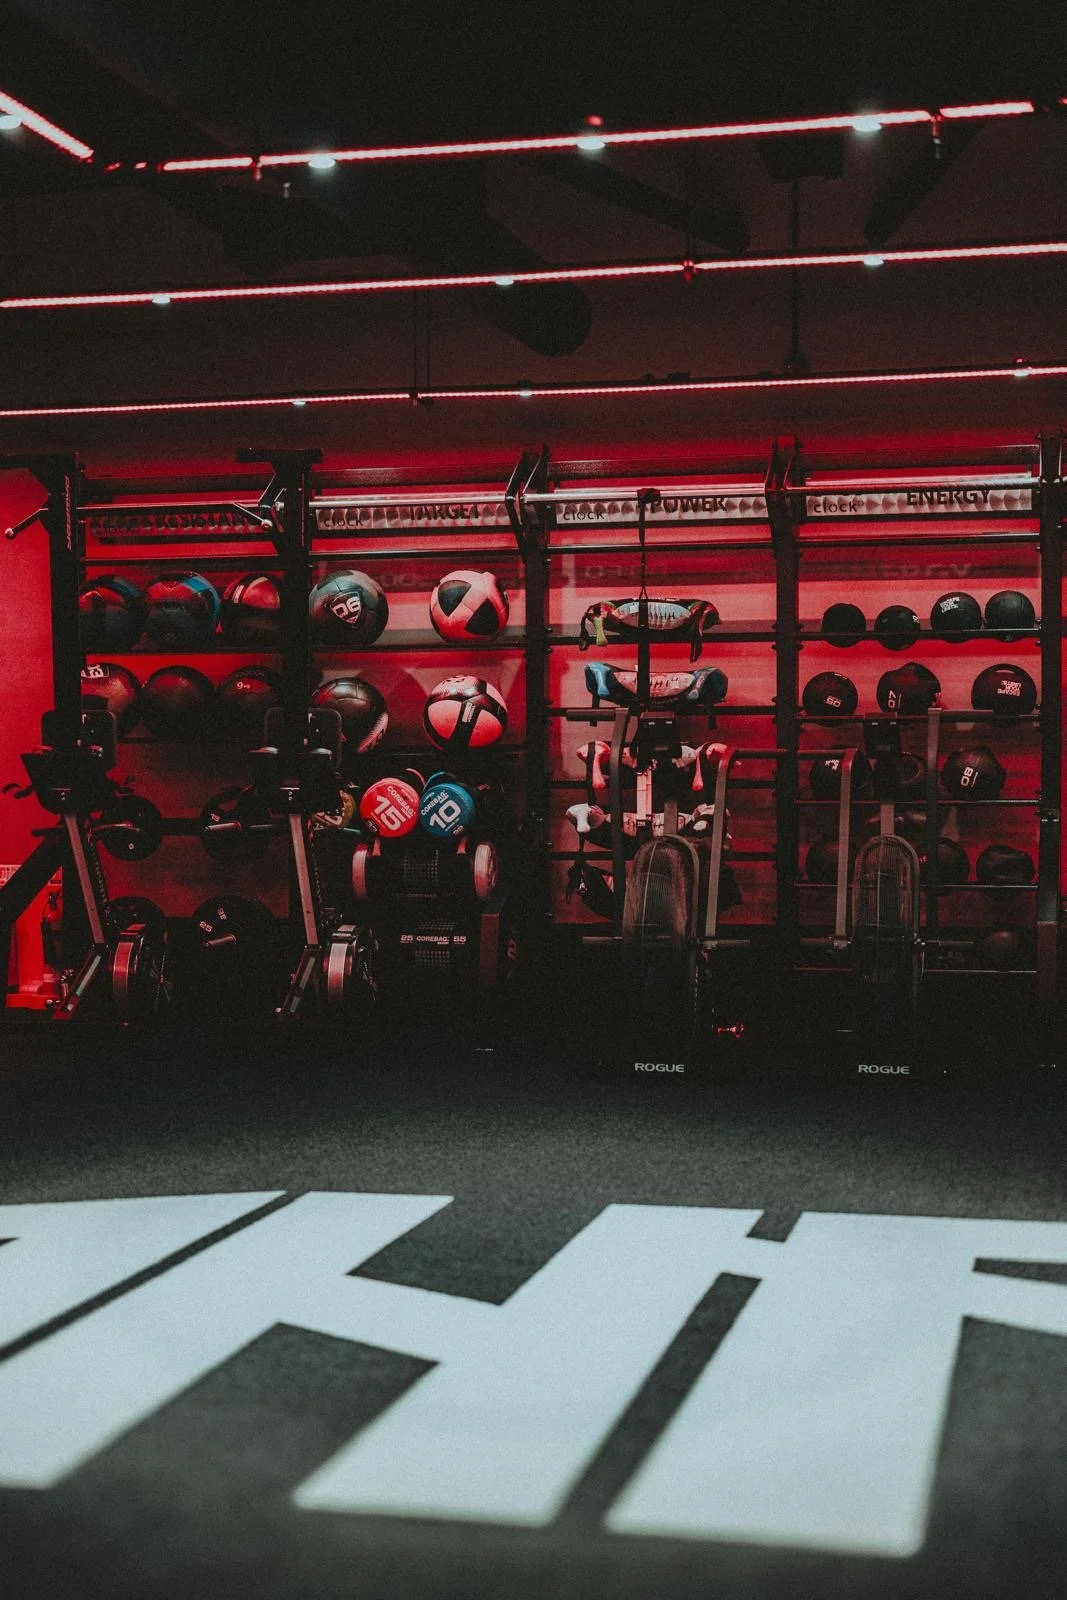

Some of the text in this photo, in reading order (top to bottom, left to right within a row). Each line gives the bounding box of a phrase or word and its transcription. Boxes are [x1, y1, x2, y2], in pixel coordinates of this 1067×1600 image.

[651, 497, 728, 513] POWER
[906, 489, 989, 506] ENERGY
[387, 785, 415, 817] COREBAG
[420, 790, 446, 816] COREBAG
[374, 795, 406, 831] 15
[429, 800, 461, 829] 10
[634, 1062, 686, 1073] ROGUE
[858, 1064, 911, 1075] ROGUE
